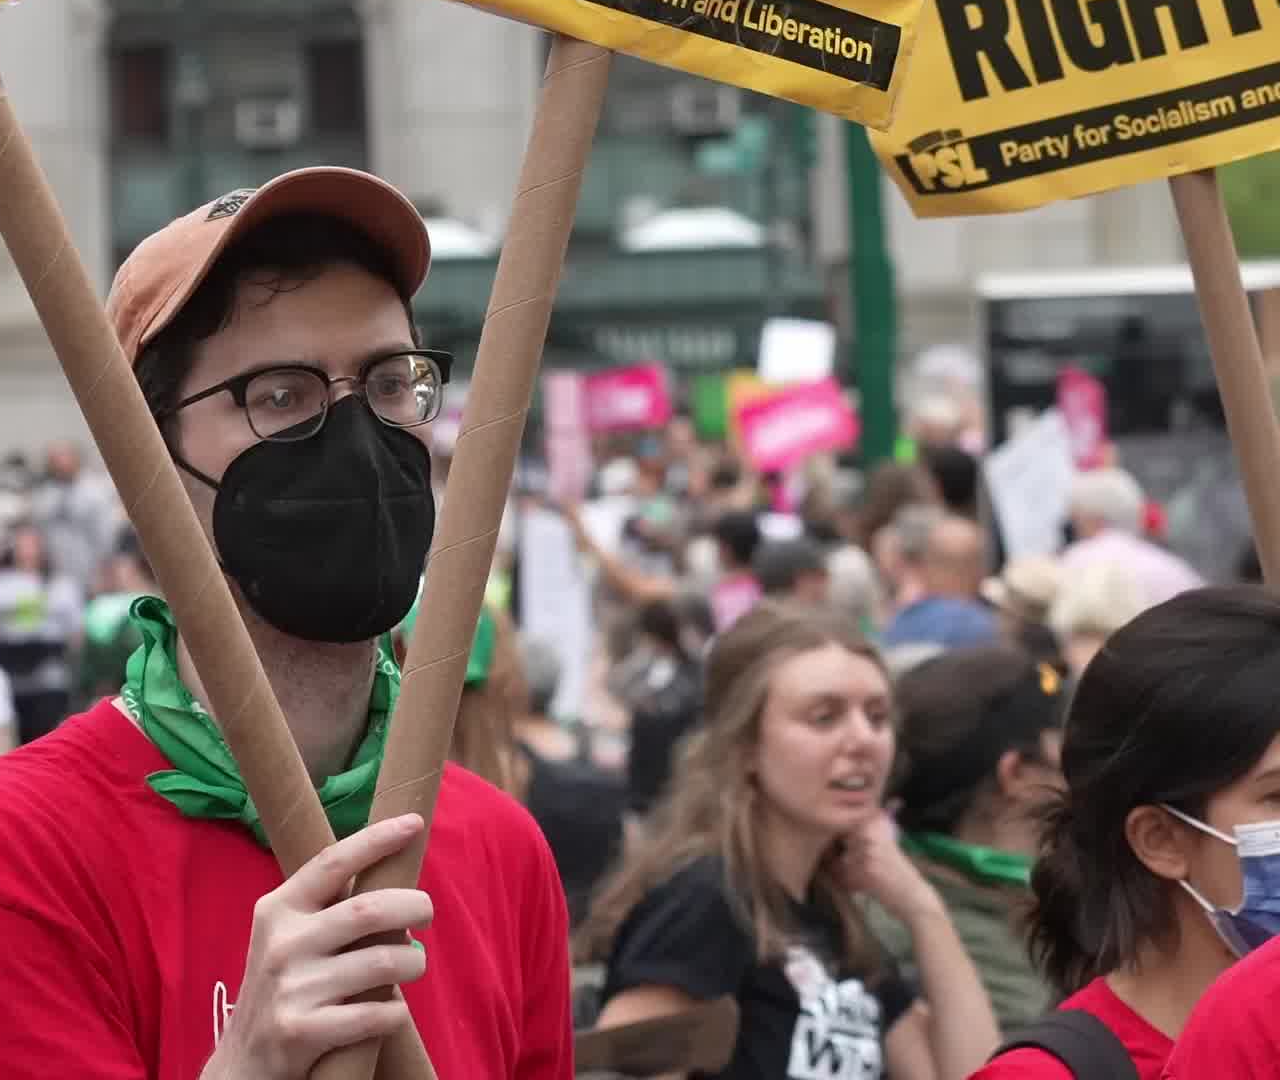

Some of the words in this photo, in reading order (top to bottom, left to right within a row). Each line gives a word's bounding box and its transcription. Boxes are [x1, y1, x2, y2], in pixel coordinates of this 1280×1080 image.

[744, 2, 873, 65] Liberation
[910, 142, 989, 191] PSL
[1000, 132, 1070, 167] Party
[1074, 122, 1110, 147] for
[1114, 92, 1235, 141] Socialism
